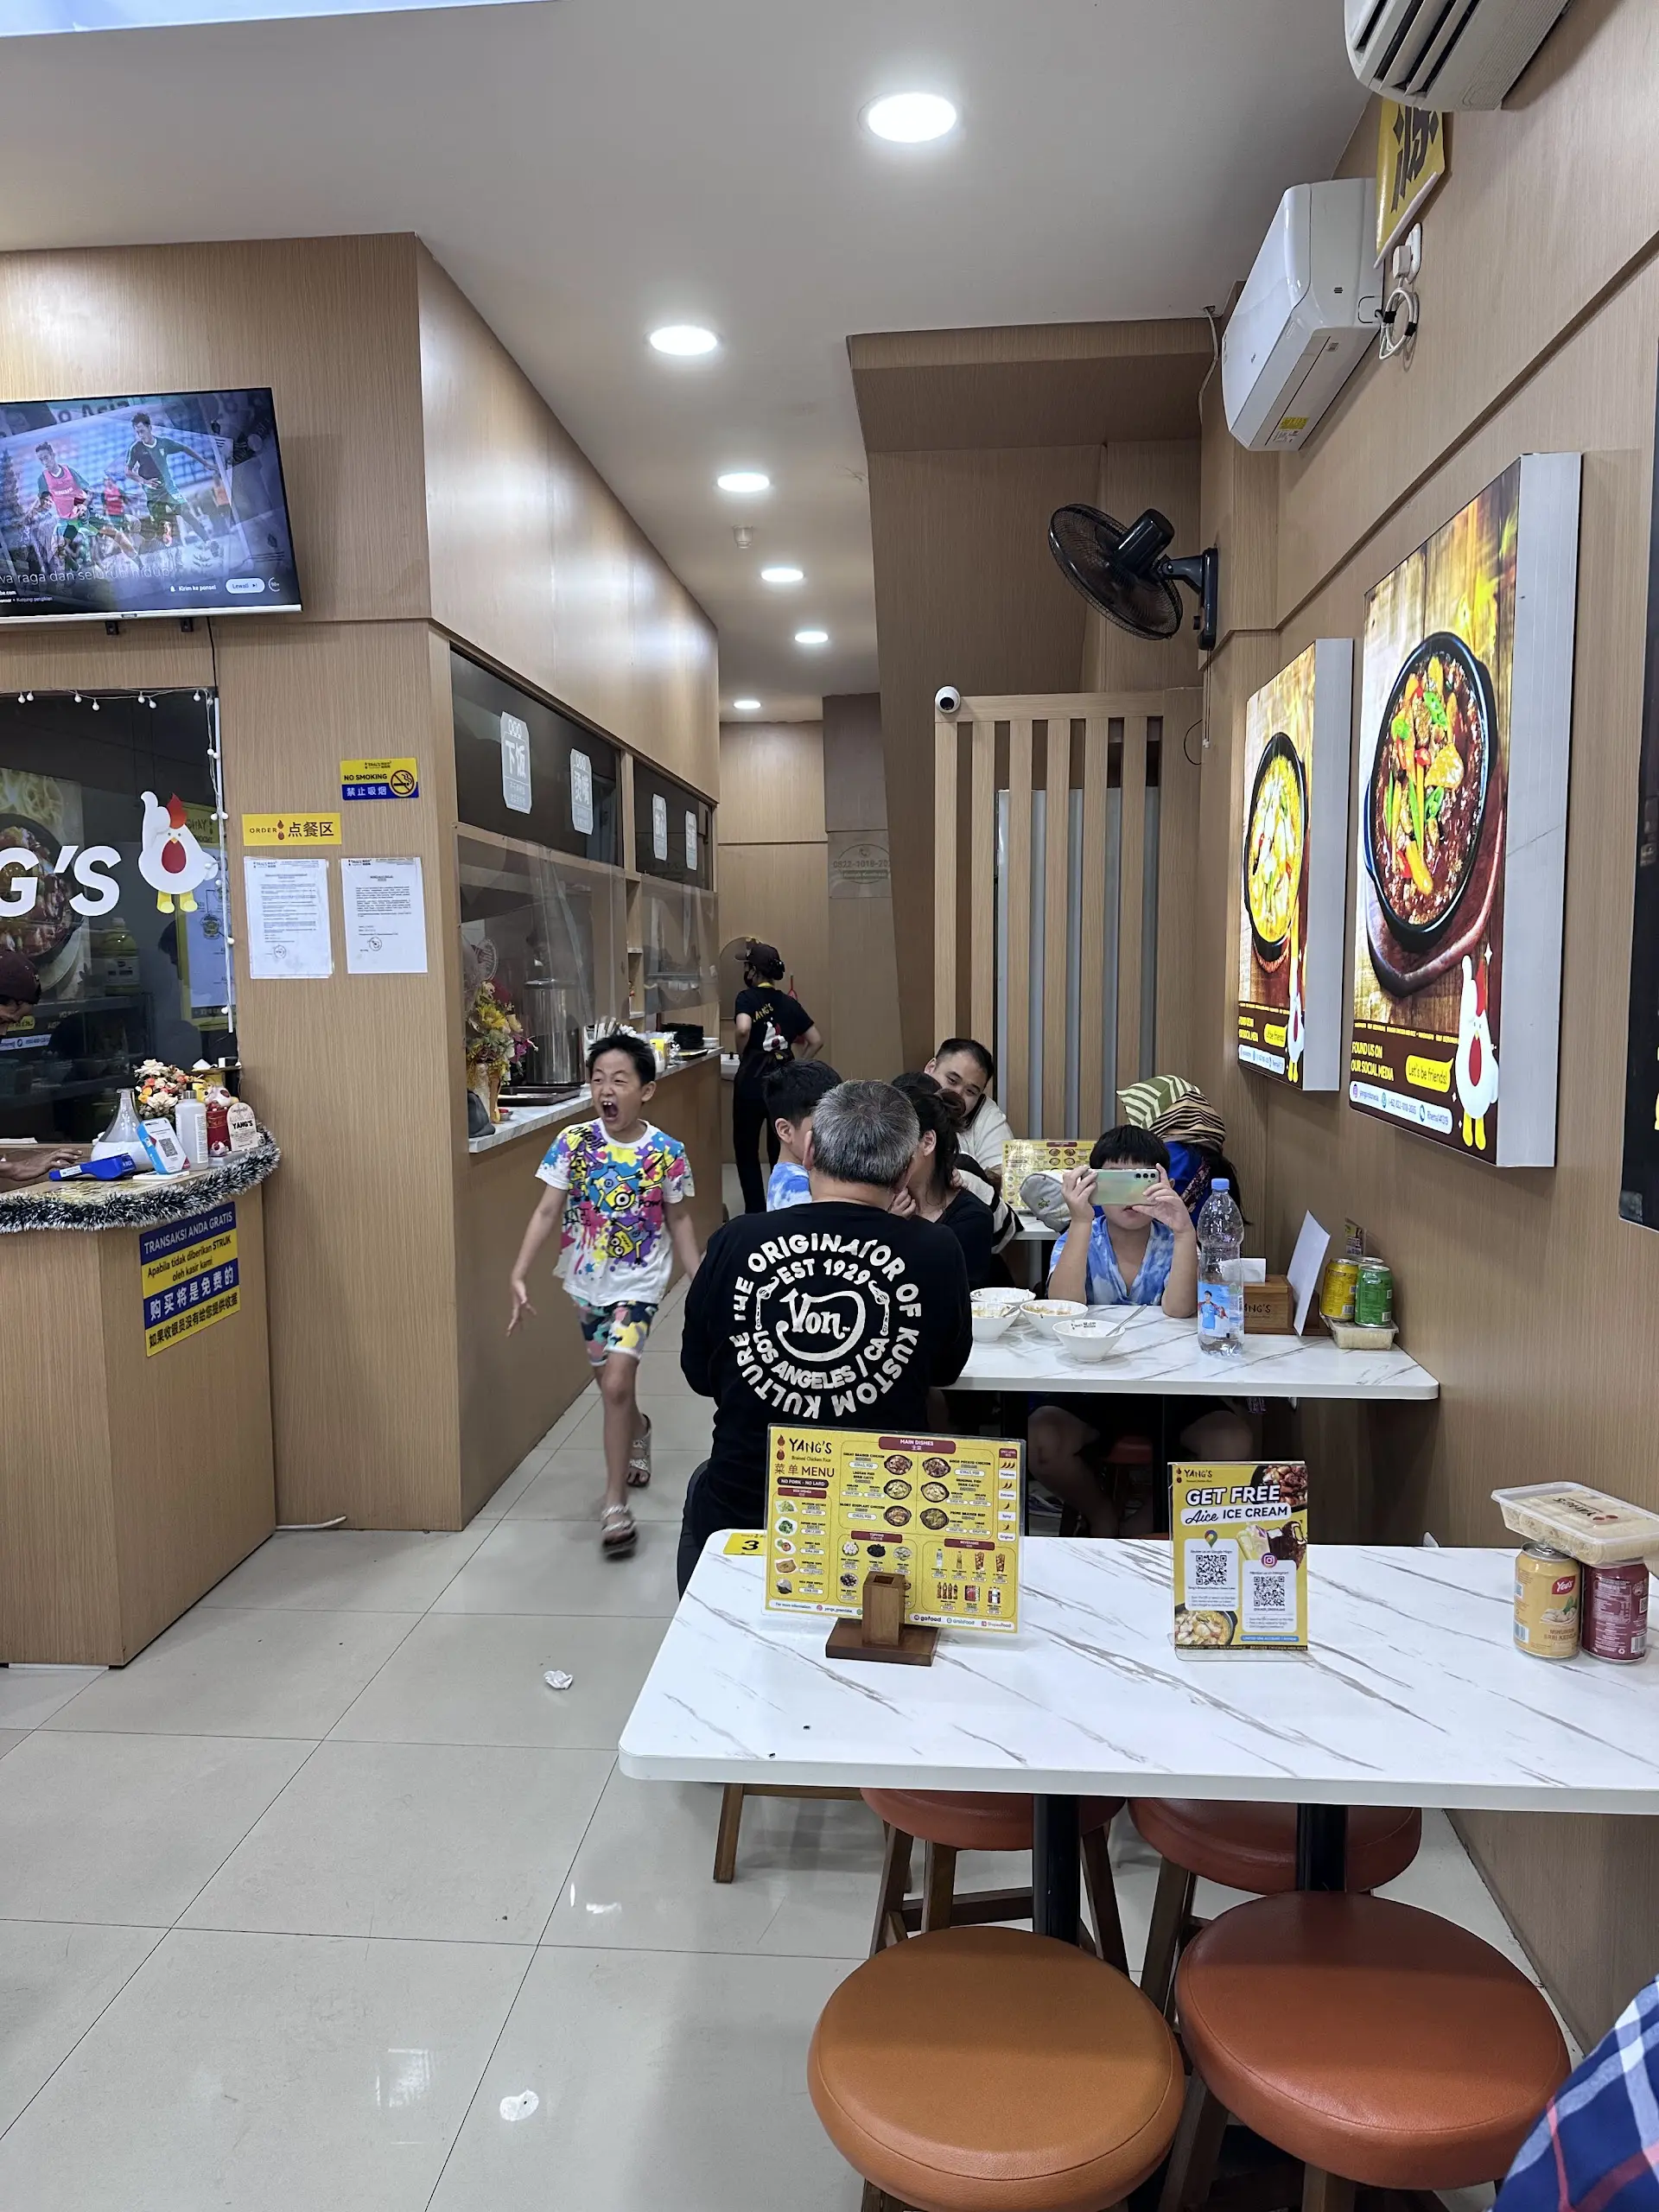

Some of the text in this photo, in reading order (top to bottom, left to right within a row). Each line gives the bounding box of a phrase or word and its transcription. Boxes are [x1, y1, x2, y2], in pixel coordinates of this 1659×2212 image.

[17, 573, 46, 585] raga
[50, 570, 74, 582] dan
[346, 785, 387, 797] 禁止吸烟
[288, 822, 334, 837] 点餐区
[0, 845, 122, 917] G'S
[753, 1002, 774, 1022] ANG'S
[1351, 1041, 1368, 1055] FOUND
[1368, 1043, 1375, 1057] US
[1361, 1061, 1377, 1077] SOCIAL
[1378, 1065, 1395, 1082] MEDIA
[1408, 1063, 1420, 1077] Let's
[1421, 1066, 1427, 1080] be
[232, 1121, 253, 1129] YANG'S
[144, 1211, 233, 1255] TRANSAKSI ANDA GRATIS
[147, 1234, 232, 1279] Apabila tidak diberikan STRUK
[747, 1232, 906, 1282] ORIGINATOR
[173, 1255, 213, 1281] oleh kasir kami
[776, 1257, 871, 1286] EST 1929
[150, 1265, 234, 1322] 购买将是免费的
[895, 1282, 922, 1319] OF
[779, 1287, 846, 1340] Von
[753, 1330, 779, 1364] LOS
[770, 1359, 857, 1389] ANGELES
[864, 1337, 891, 1362] CA
[729, 1332, 821, 1420] KULTURE
[830, 1325, 920, 1417] KUSTOM
[789, 1438, 832, 1454] YANG'S
[774, 1463, 799, 1476] 菜单
[801, 1465, 835, 1478] MENU
[1184, 1469, 1213, 1478] YANG'S
[1186, 1484, 1281, 1505] GET FREE
[1185, 1506, 1288, 1524] Aice ICE CREAM
[741, 1540, 760, 1551] 3
